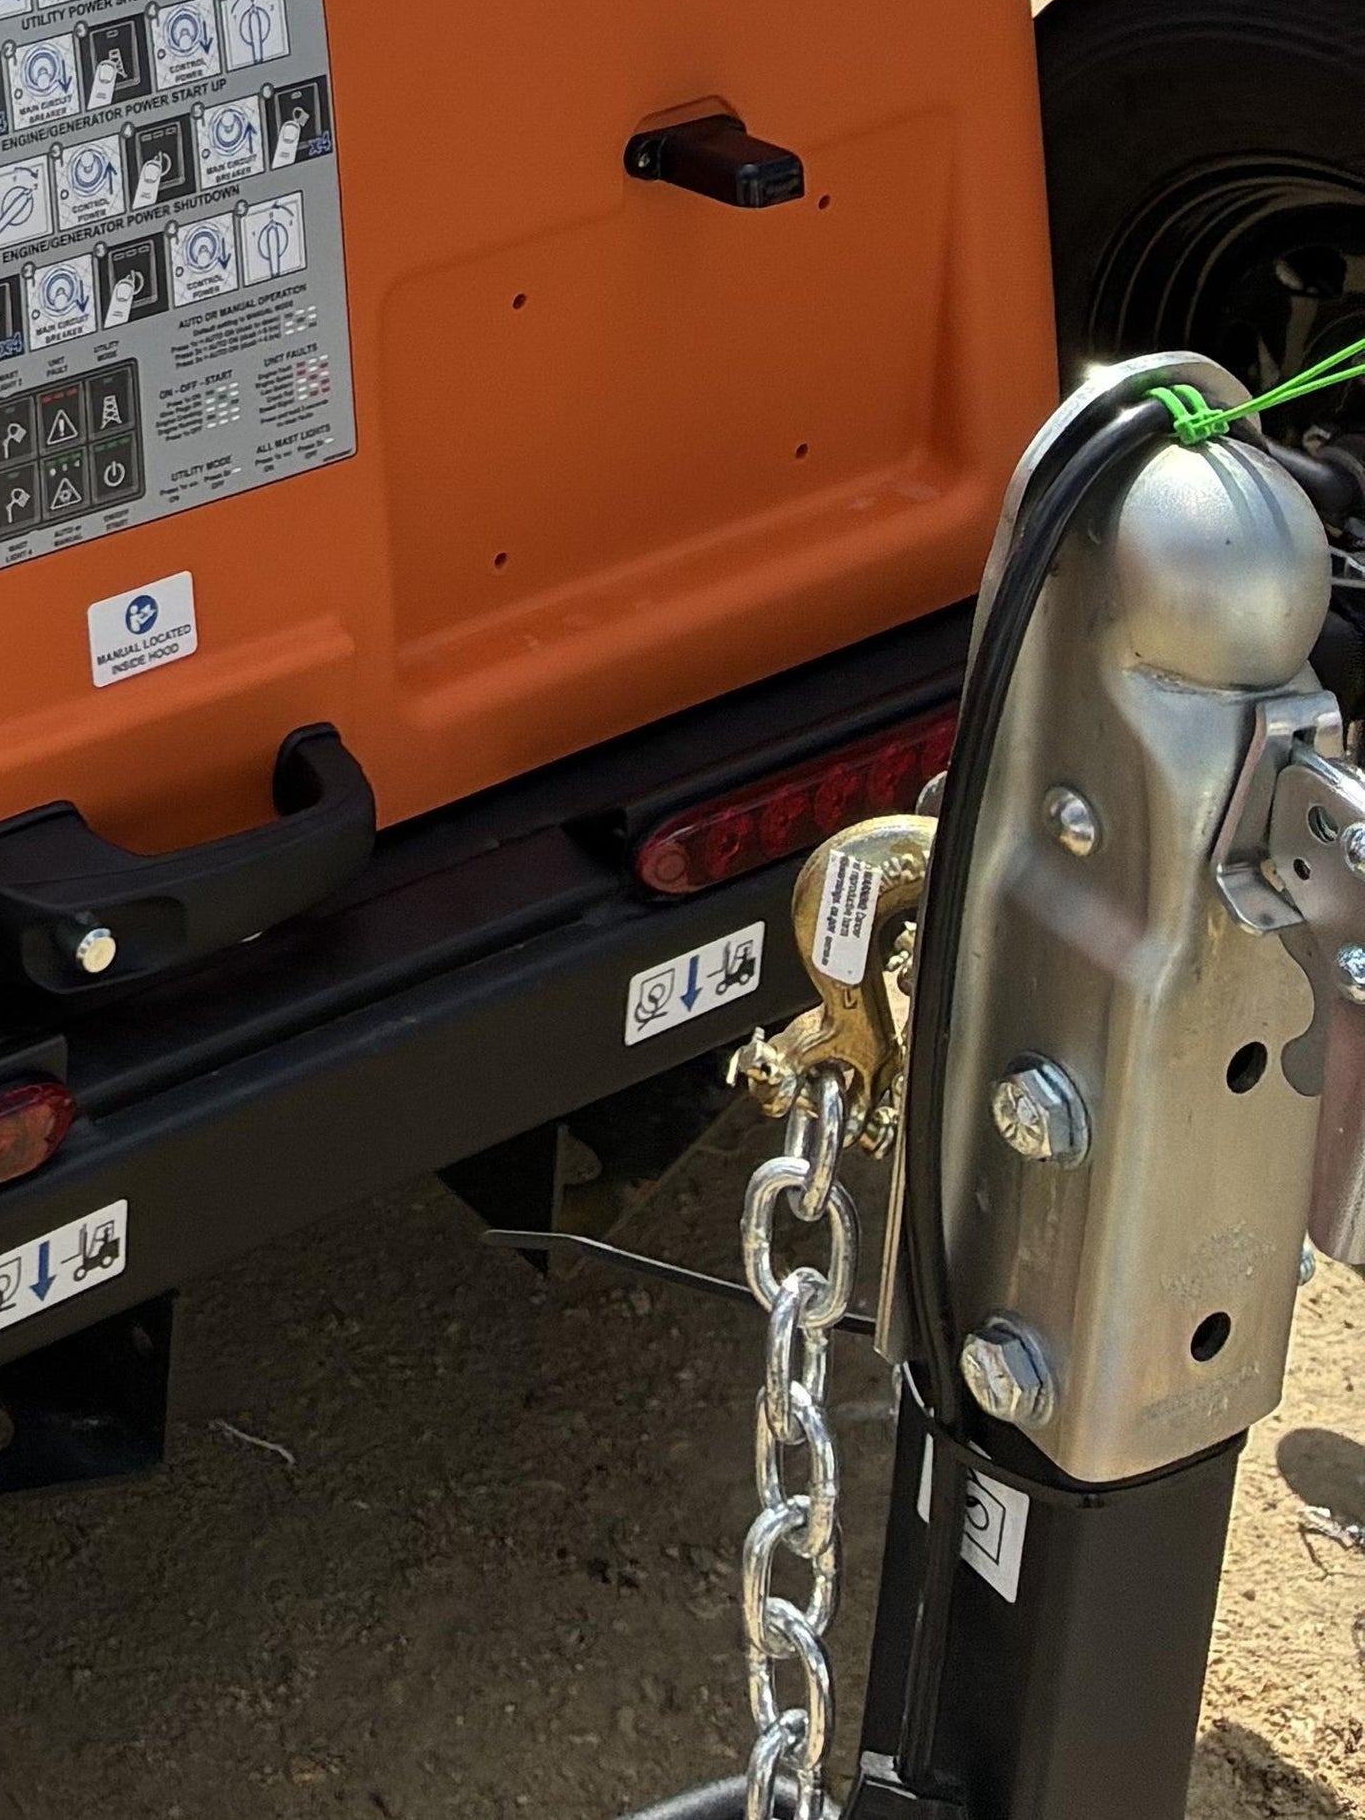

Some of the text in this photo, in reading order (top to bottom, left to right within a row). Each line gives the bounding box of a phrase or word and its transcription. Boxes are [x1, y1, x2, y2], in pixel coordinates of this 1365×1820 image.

[21, 10, 65, 31] UTILITY
[67, 0, 112, 19] POWER
[1, 80, 227, 151] ENGINE/GENERATOR POWER START UP
[2, 185, 239, 262] ENGINE/GENERATOR POWER SHUTDOWN
[179, 314, 204, 329] AUTO
[220, 300, 257, 317] MANUAL
[258, 284, 307, 306] OPERATION
[97, 624, 191, 665] MANUAL LOCATED
[112, 643, 179, 674] INSIDE HOOD
